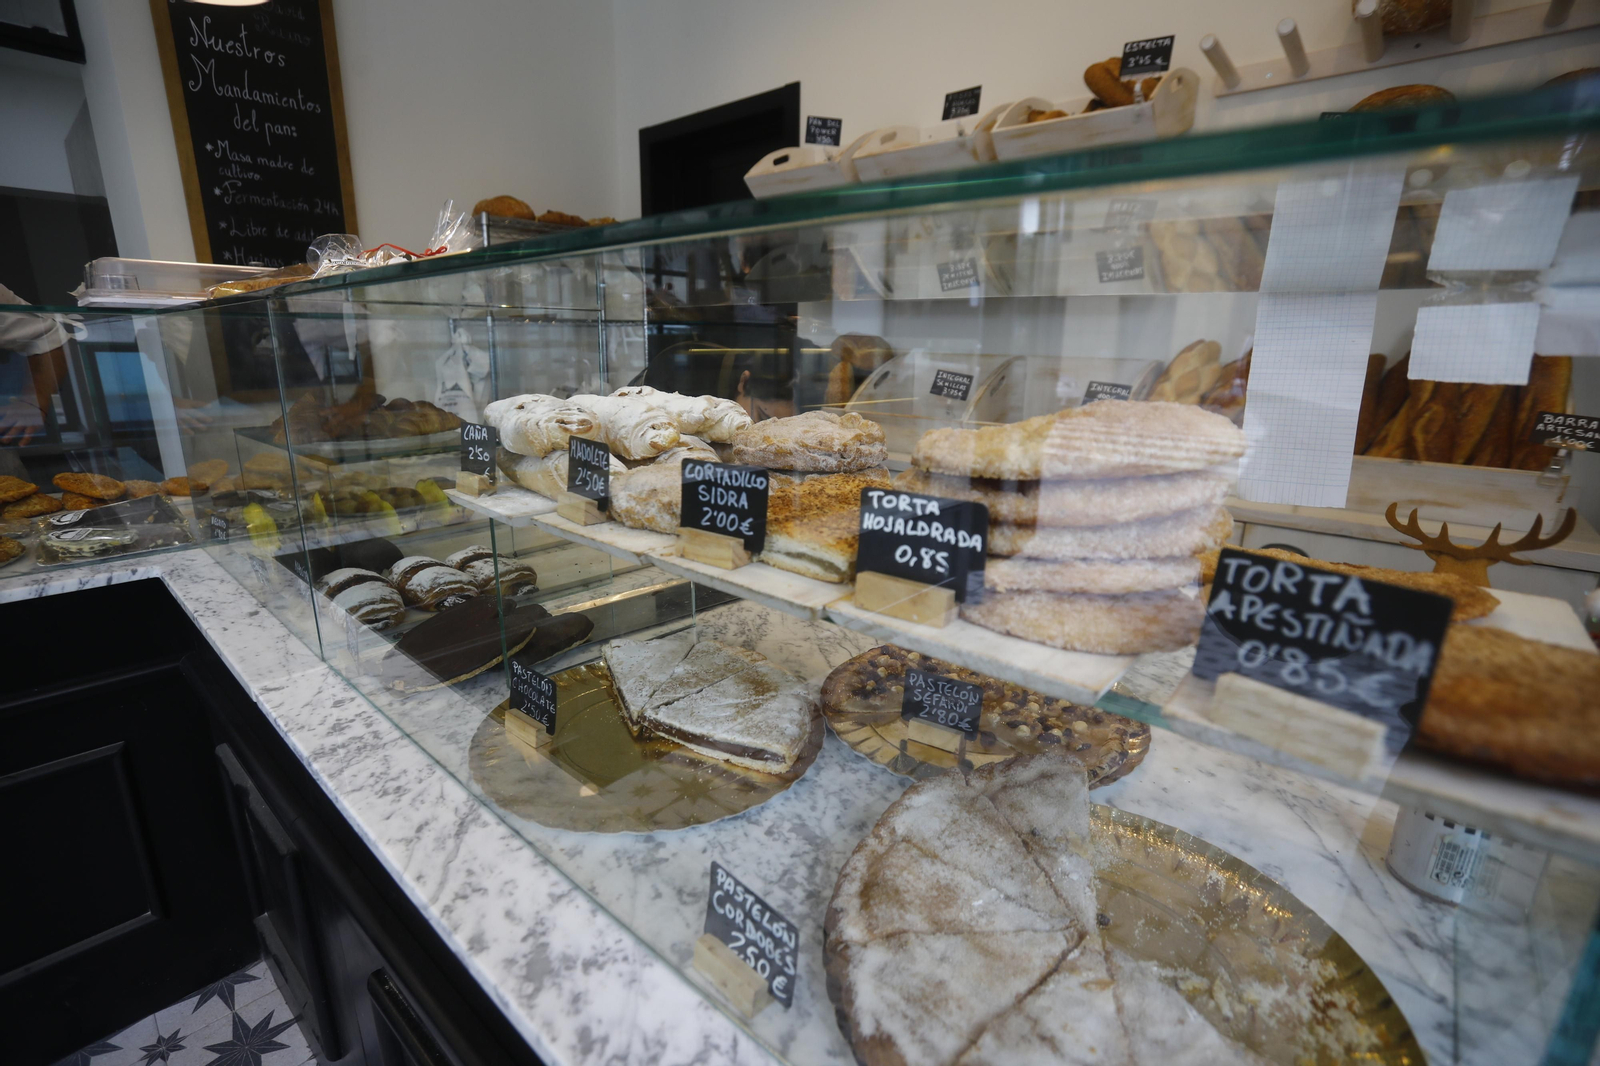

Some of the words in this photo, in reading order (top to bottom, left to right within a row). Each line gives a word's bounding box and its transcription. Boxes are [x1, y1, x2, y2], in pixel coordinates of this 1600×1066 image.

[189, 15, 285, 67] Nuestros
[1125, 37, 1171, 53] ESPELTA
[189, 53, 321, 113] Mandamientos
[233, 102, 259, 133] del
[265, 121, 298, 146] pan:
[214, 140, 253, 163] Masa
[257, 154, 294, 171] madre
[301, 158, 315, 176] de
[222, 180, 309, 212] Fermentación
[314, 199, 340, 215] 24h
[229, 216, 268, 237] Libre
[275, 222, 290, 238] de
[937, 371, 971, 385] INTEGRAL
[1091, 383, 1130, 396] INTEGRAL
[463, 424, 488, 441] CAÑA
[1542, 413, 1599, 430] BARRA
[468, 445, 491, 462] 2'50
[575, 467, 605, 497] 2'50€
[685, 463, 767, 490] CORTADILLO
[698, 484, 748, 510] SIDRA
[867, 490, 940, 516] TORTA
[701, 506, 754, 535] 2'00€
[862, 512, 983, 552] HOJALDRADA
[894, 544, 949, 573] 0,85
[1223, 557, 1372, 616] TORTA
[1208, 589, 1435, 675] APESTIÑADA
[512, 661, 553, 696] PASTELÓN
[909, 673, 979, 703] PASTELÓN
[1237, 640, 1398, 708] 0'85€
[512, 677, 556, 714] CHOCOLATE
[919, 704, 973, 731] 2'80€
[716, 868, 796, 949] PASTELÓN
